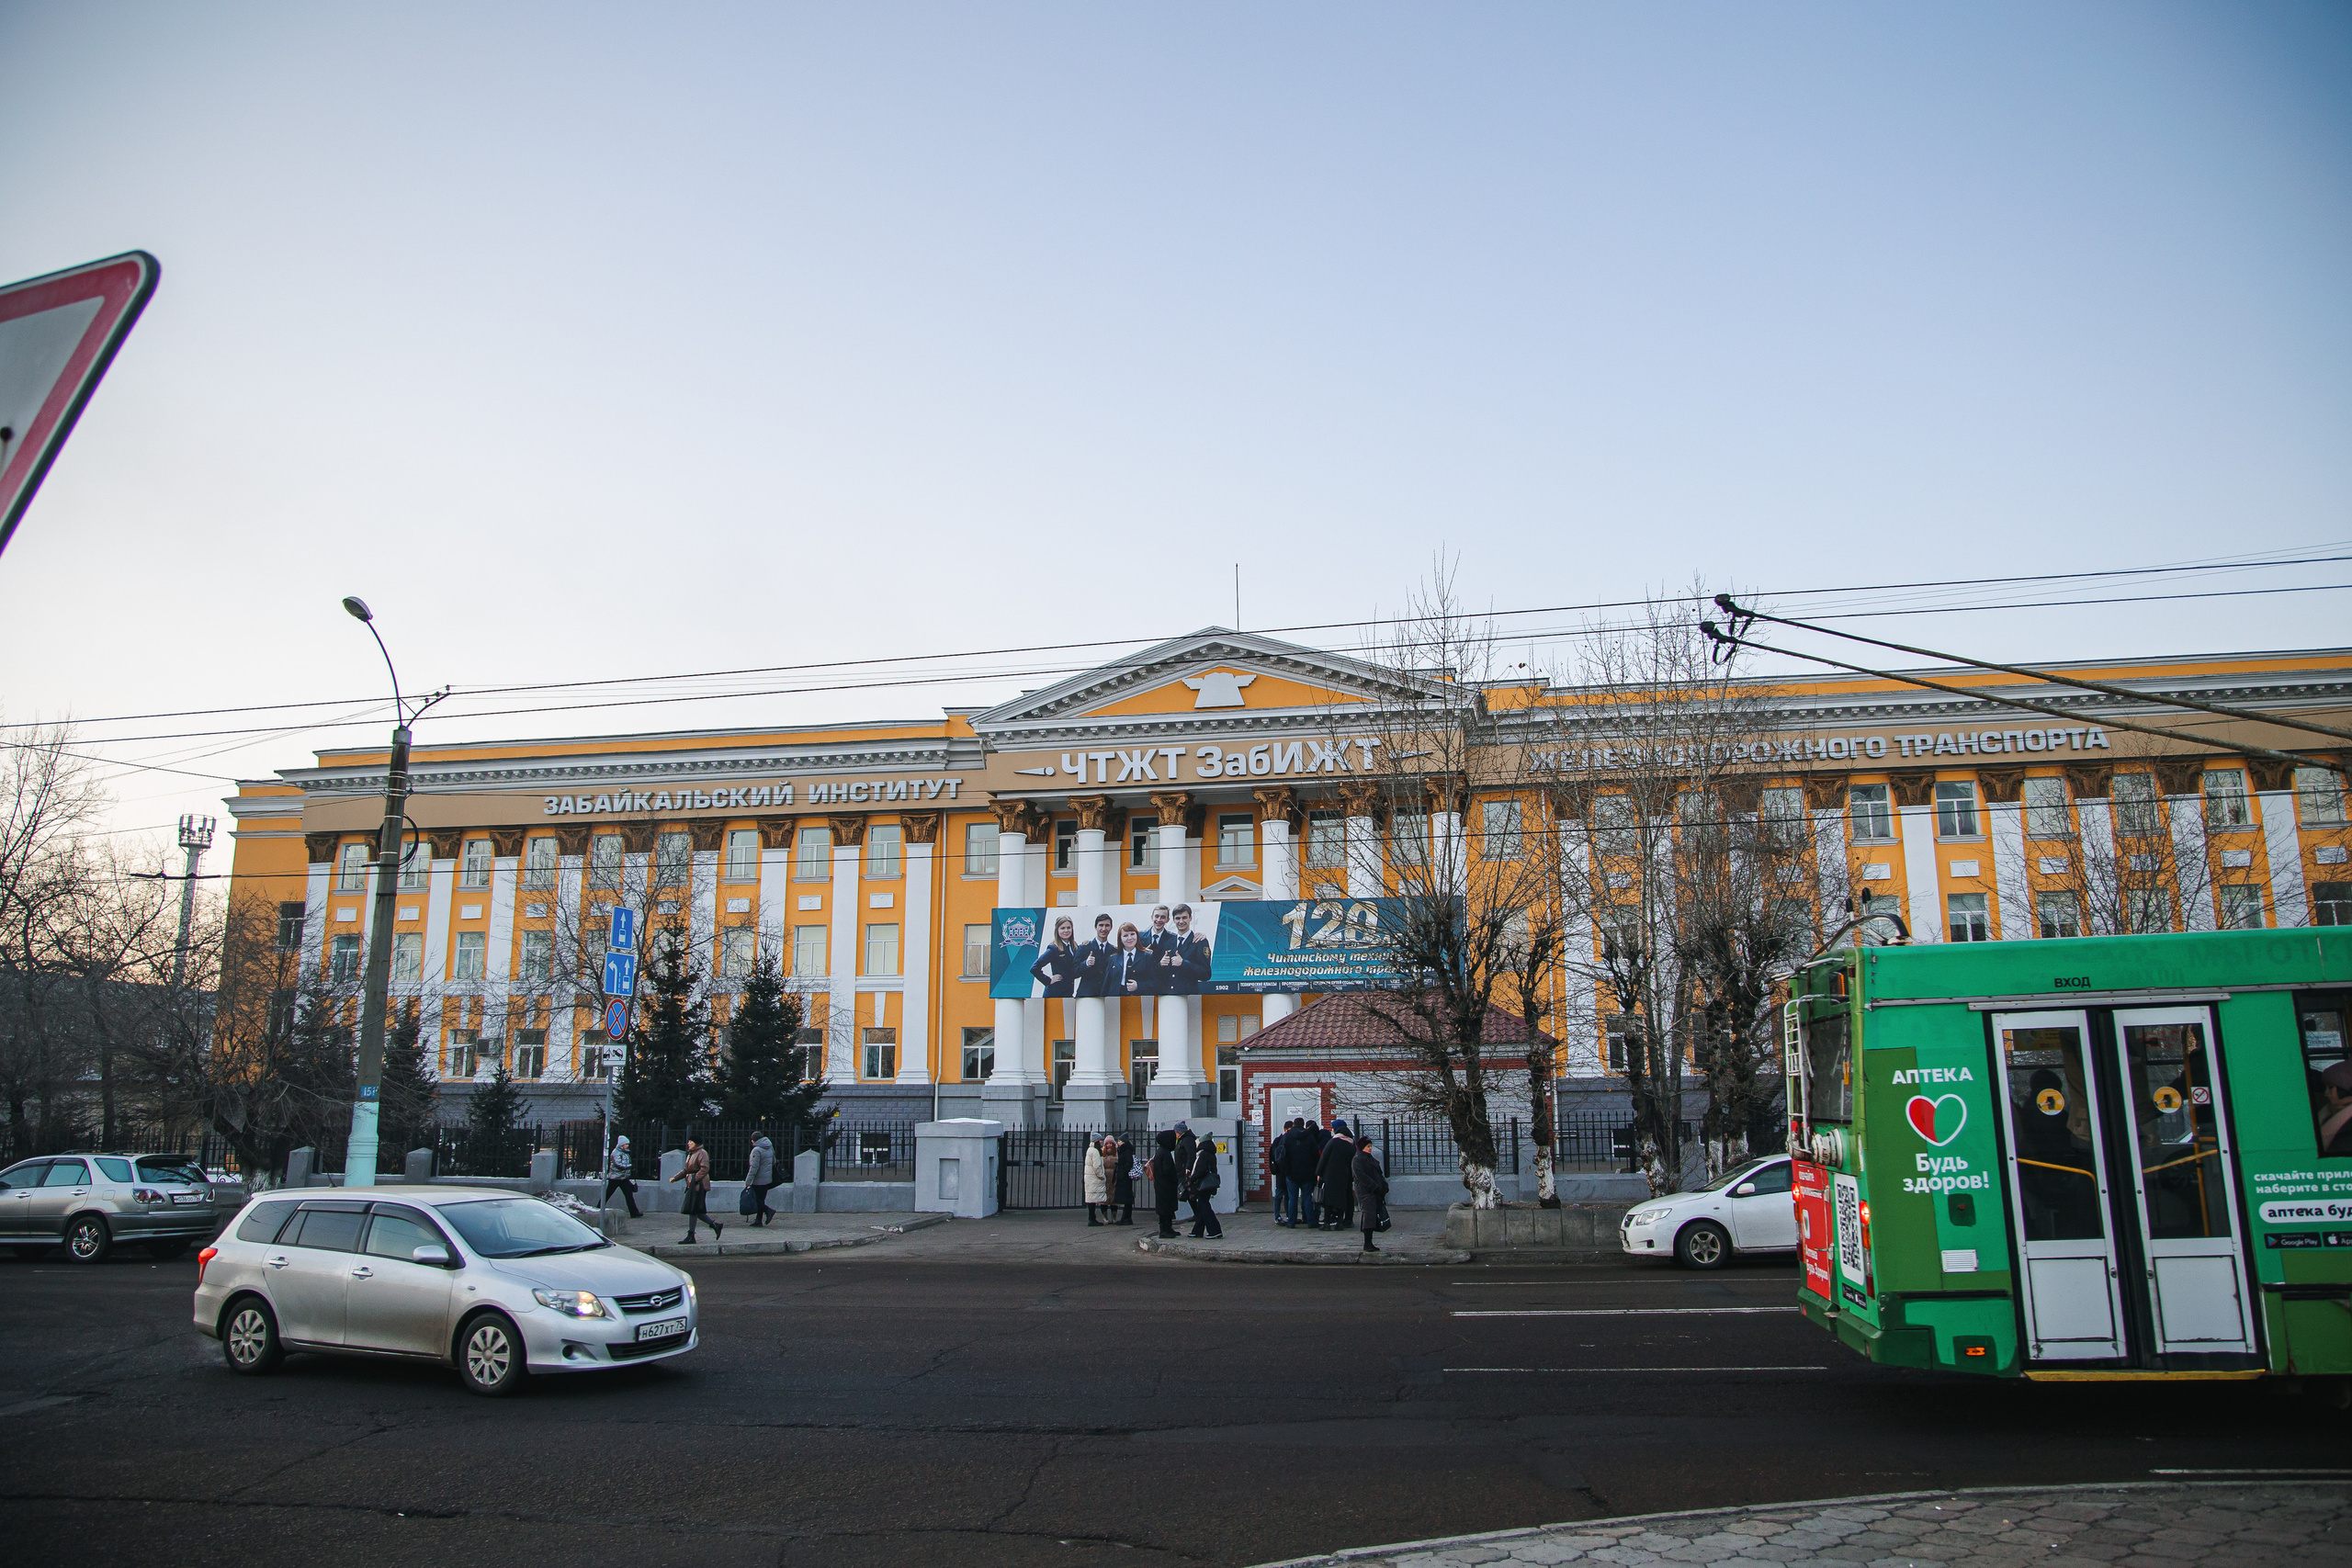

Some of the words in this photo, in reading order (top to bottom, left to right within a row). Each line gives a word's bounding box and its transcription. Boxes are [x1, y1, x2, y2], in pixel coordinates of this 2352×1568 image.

[1894, 727, 2110, 757] ТРАНСПОРТА
[1061, 747, 1186, 784] ЧТЖТ
[1195, 738, 1382, 778] ЗабИЖТ
[543, 781, 794, 816] ЗАБАЙКАЛЬСКИЙ
[808, 778, 963, 805] ИНСТИТУТ
[1282, 901, 1380, 950] 120
[1267, 952, 1347, 964] Читинскому
[2054, 976, 2091, 988] ВХОД
[1892, 1066, 1973, 1085] АПТЕКА
[1915, 1153, 1969, 1176] Будь
[1903, 1170, 1990, 1195] здоров!
[2254, 1170, 2313, 1181] скачайте
[2316, 1170, 2352, 1181] прил
[2256, 1184, 2318, 1195] наберите
[2322, 1184, 2330, 1192] в
[2267, 1208, 2324, 1217] аптека
